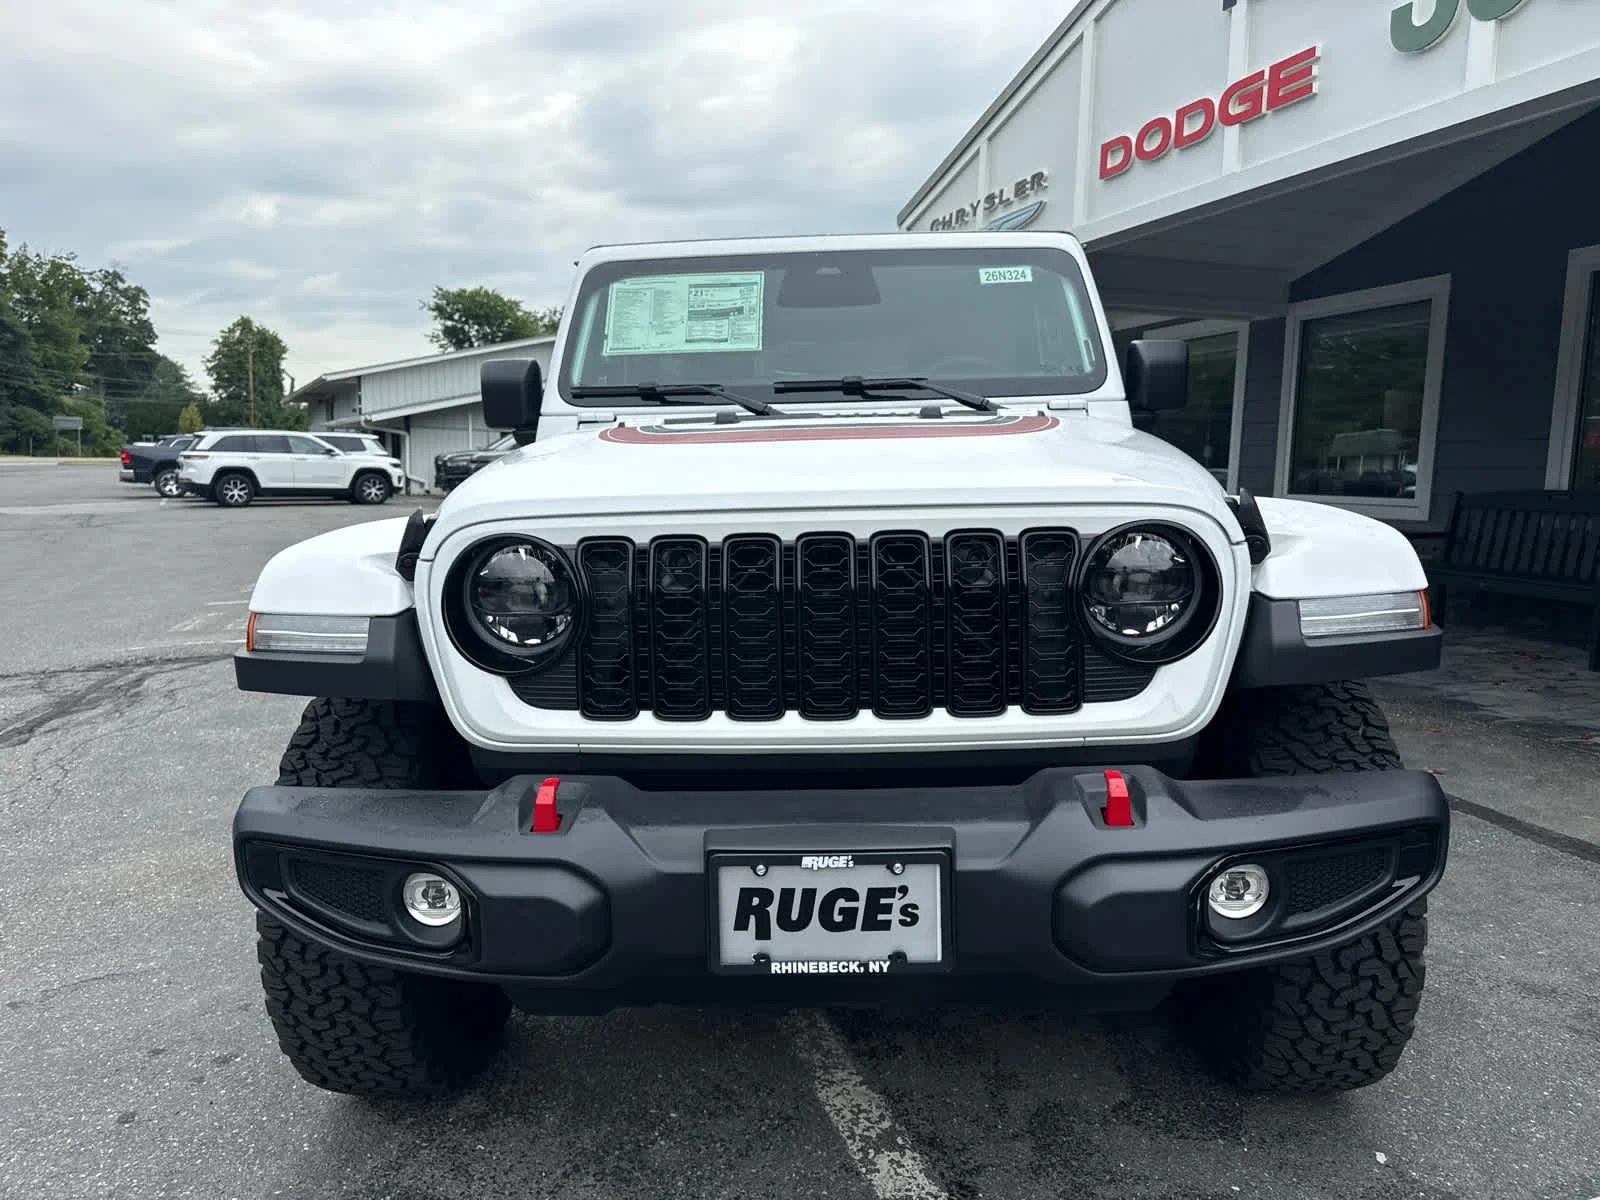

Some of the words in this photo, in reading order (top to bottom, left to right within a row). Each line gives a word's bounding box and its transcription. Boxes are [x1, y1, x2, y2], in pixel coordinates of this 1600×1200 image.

[1099, 46, 1316, 180] DODGE
[930, 171, 1047, 231] CHRYSLER
[984, 270, 1026, 281] 26N324
[733, 885, 920, 940] RUGE's
[771, 961, 864, 974] RHINEBECK,
[868, 961, 891, 973] NY
